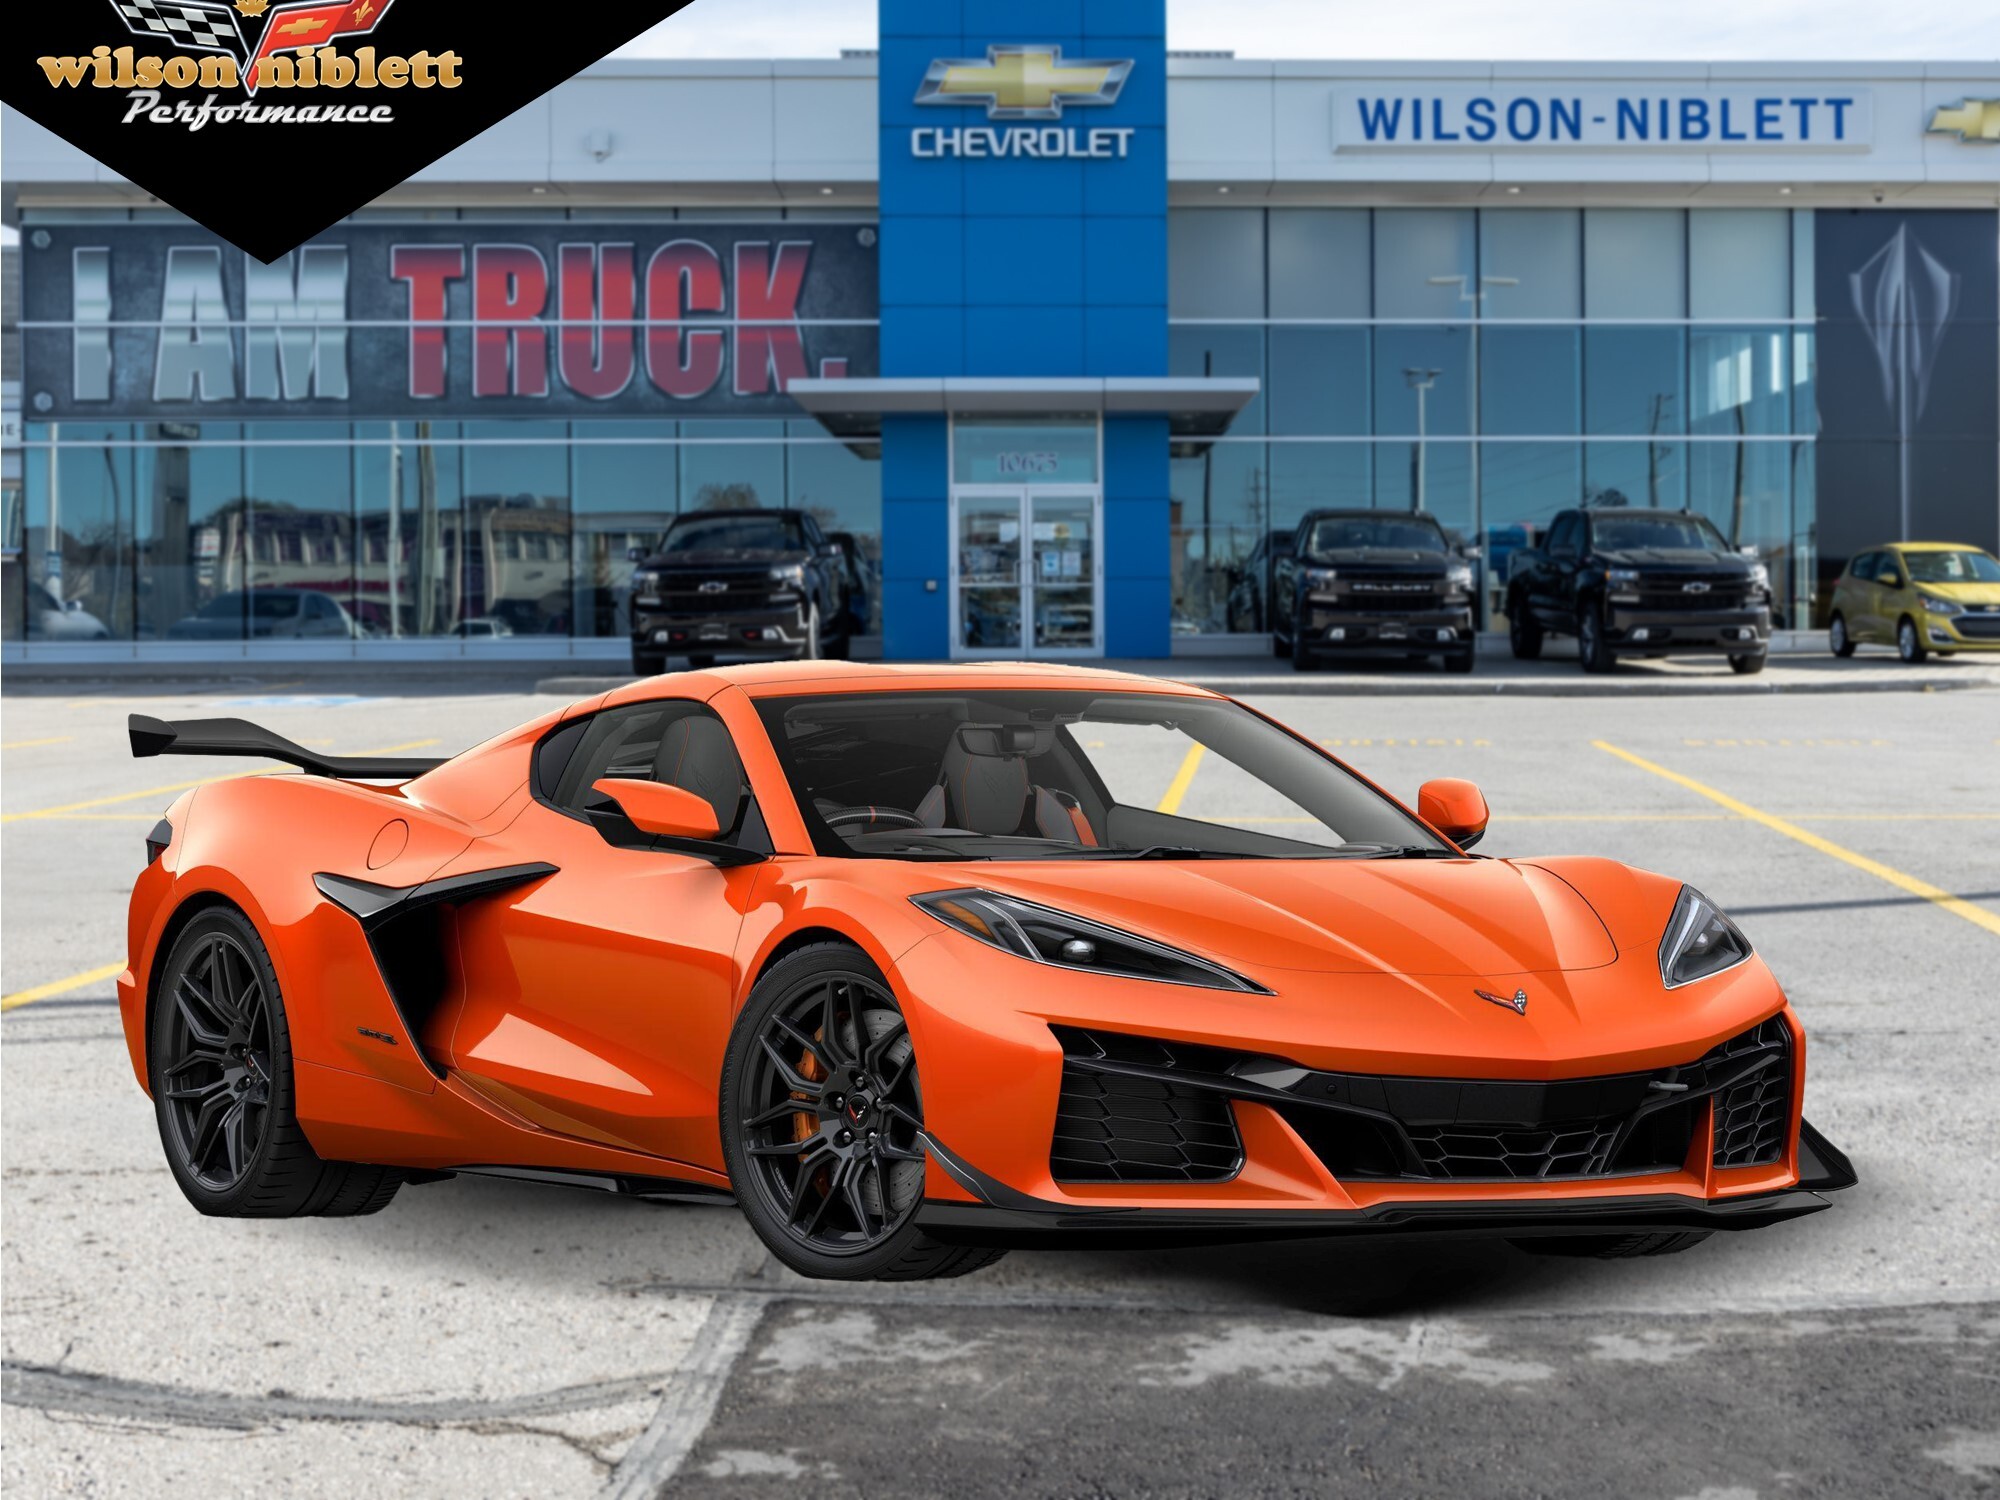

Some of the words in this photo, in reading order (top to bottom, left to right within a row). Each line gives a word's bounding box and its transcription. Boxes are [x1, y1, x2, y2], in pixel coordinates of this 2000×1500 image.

[1357, 97, 1853, 142] WILSON-NIBLETT
[911, 127, 1135, 158] CHEVROLET
[72, 246, 112, 401] I
[153, 244, 349, 401] AM
[997, 451, 1059, 474] 10675
